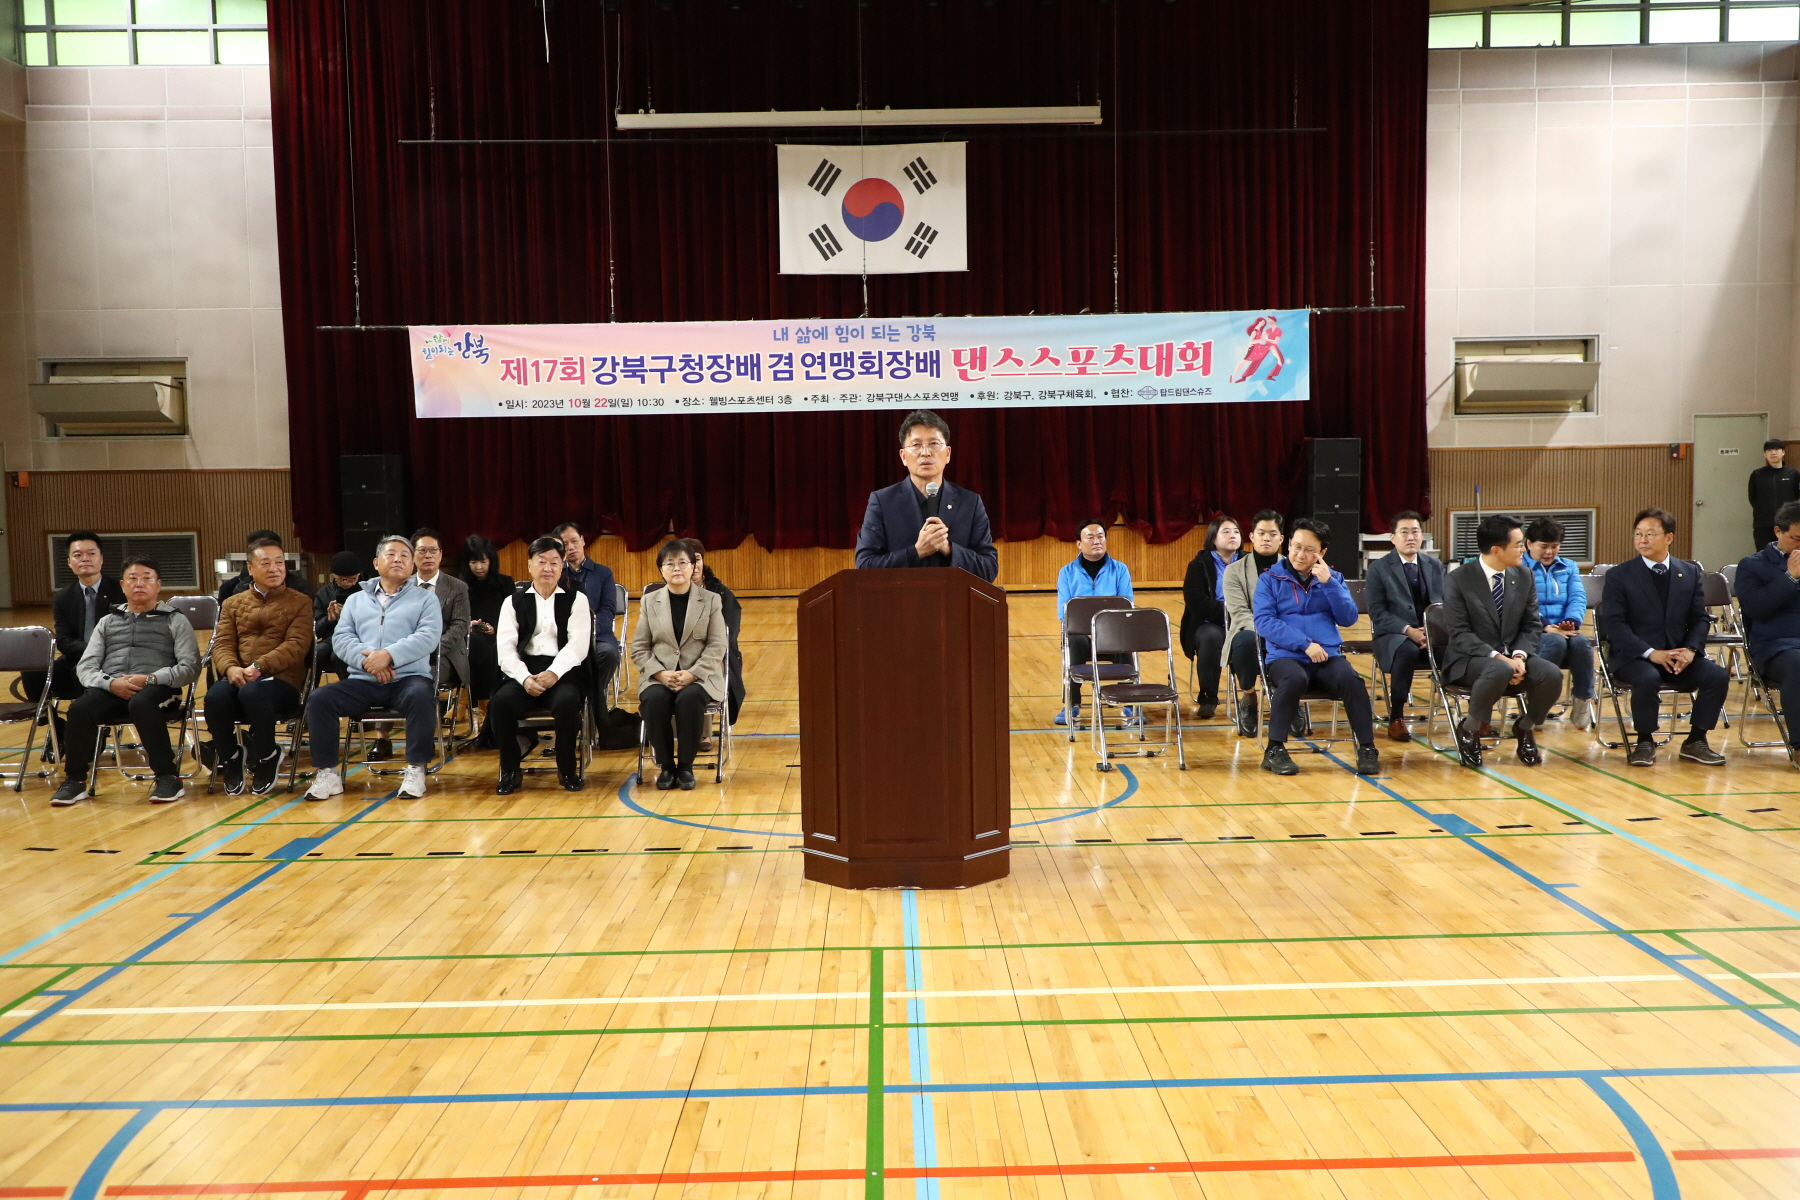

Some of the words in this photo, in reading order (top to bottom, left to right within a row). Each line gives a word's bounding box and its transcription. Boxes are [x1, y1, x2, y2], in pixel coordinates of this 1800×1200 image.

[773, 329, 789, 342] 내
[795, 326, 828, 344] 삶에
[835, 325, 865, 343] 힘이
[871, 325, 901, 342] 되는
[906, 324, 936, 342] 강북
[454, 332, 489, 364] 강북
[500, 356, 586, 386] 제17회
[591, 353, 762, 385] 강북구청장배
[768, 352, 794, 382] 겸
[800, 349, 941, 381] 연맹회장배
[951, 342, 1213, 382] 댄스스포츠대회
[505, 399, 528, 409] 일시:
[532, 399, 564, 409] 2023년
[568, 398, 591, 408] 10월
[594, 398, 633, 408] 22일(일)
[637, 398, 665, 407] 10:30
[682, 397, 705, 407] 장소:
[778, 395, 793, 404] 3층
[810, 394, 829, 403] 주최
[839, 393, 862, 403] 주관:
[866, 392, 959, 402] 강북구댄스스포츠연맹
[977, 391, 999, 400] 후원:
[1160, 387, 1212, 397] 탑드림댄스슈즈
